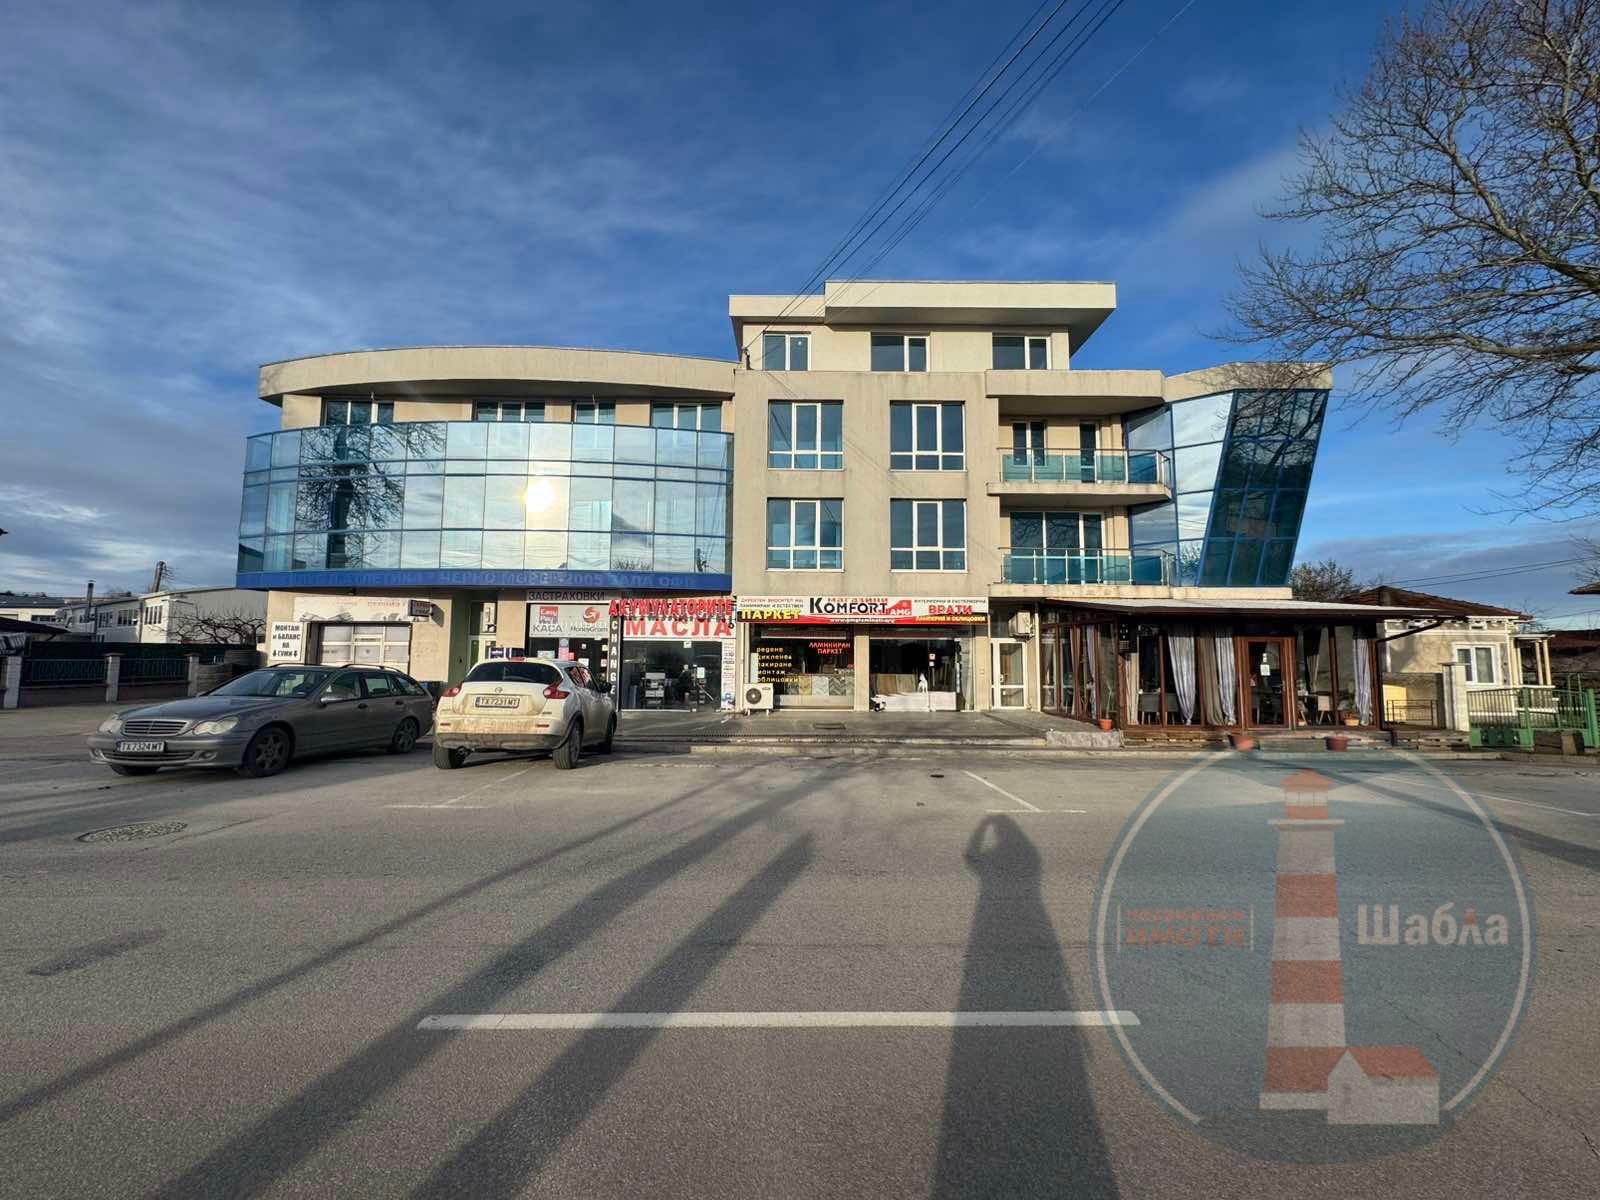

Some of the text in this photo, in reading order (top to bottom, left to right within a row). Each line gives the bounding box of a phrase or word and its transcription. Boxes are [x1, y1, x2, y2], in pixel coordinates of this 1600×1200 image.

[528, 591, 605, 601] ЗАСТРАХОВКИ
[609, 599, 733, 616] АКУМУЛАТОРИТЕ
[928, 604, 973, 615] ВРАТИ
[741, 608, 801, 620] ПАРКЕТ
[533, 624, 563, 633] КАСА
[625, 619, 732, 636] МАСЛА
[610, 620, 618, 694] CHANGE
